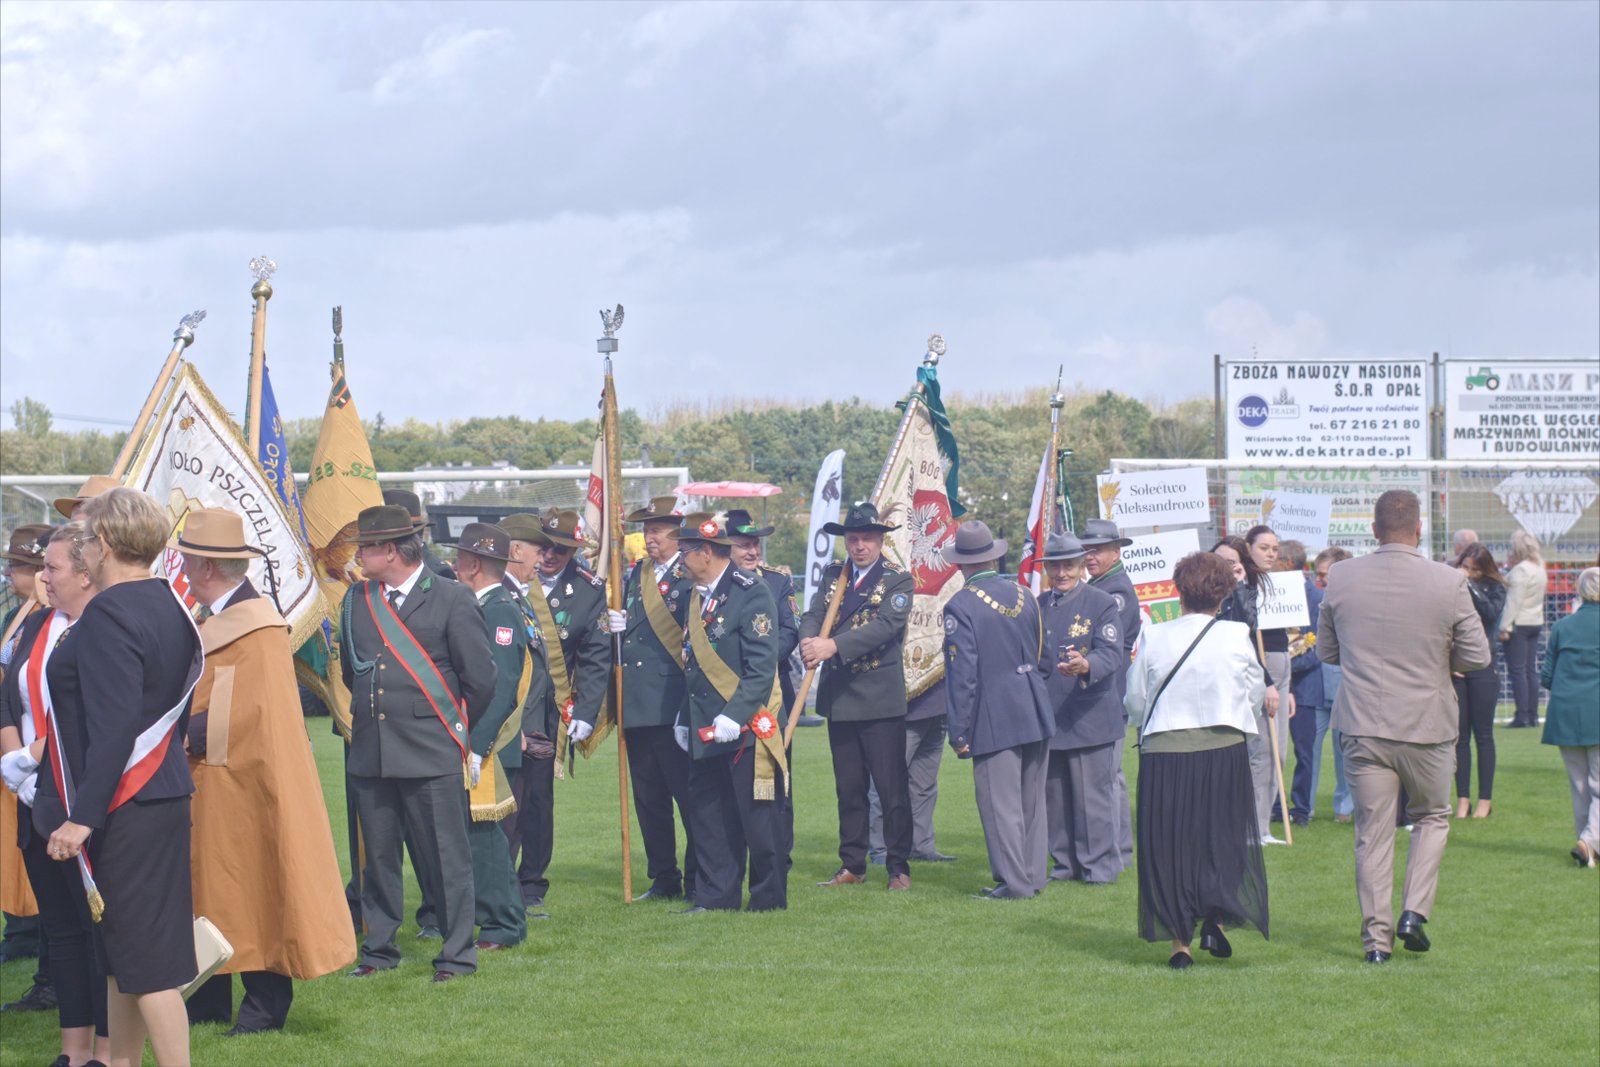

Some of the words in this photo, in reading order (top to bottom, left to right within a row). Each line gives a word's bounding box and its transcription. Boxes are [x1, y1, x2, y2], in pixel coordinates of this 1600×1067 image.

[1287, 365, 1350, 379] NAWOZY
[1358, 365, 1421, 379] NASIONA
[1386, 383, 1421, 397] OPAŁ
[1237, 407, 1268, 418] DEKA
[1270, 408, 1298, 416] TRADE
[1332, 405, 1363, 414] partner
[1375, 404, 1419, 412] rolnictwie
[1309, 422, 1327, 430] tel.
[1330, 419, 1347, 430] 67
[1352, 419, 1377, 430] 216
[1381, 419, 1398, 430] 21
[1403, 419, 1420, 430] 80
[1480, 414, 1538, 426] HANDEL
[1454, 428, 1541, 440] MASZYNAMI
[1244, 445, 1411, 458] www.dekatrade.pl
[1115, 499, 1204, 515] Aleksandrowo
[1122, 546, 1162, 559] GMINA
[1124, 559, 1166, 574] WAPNO
